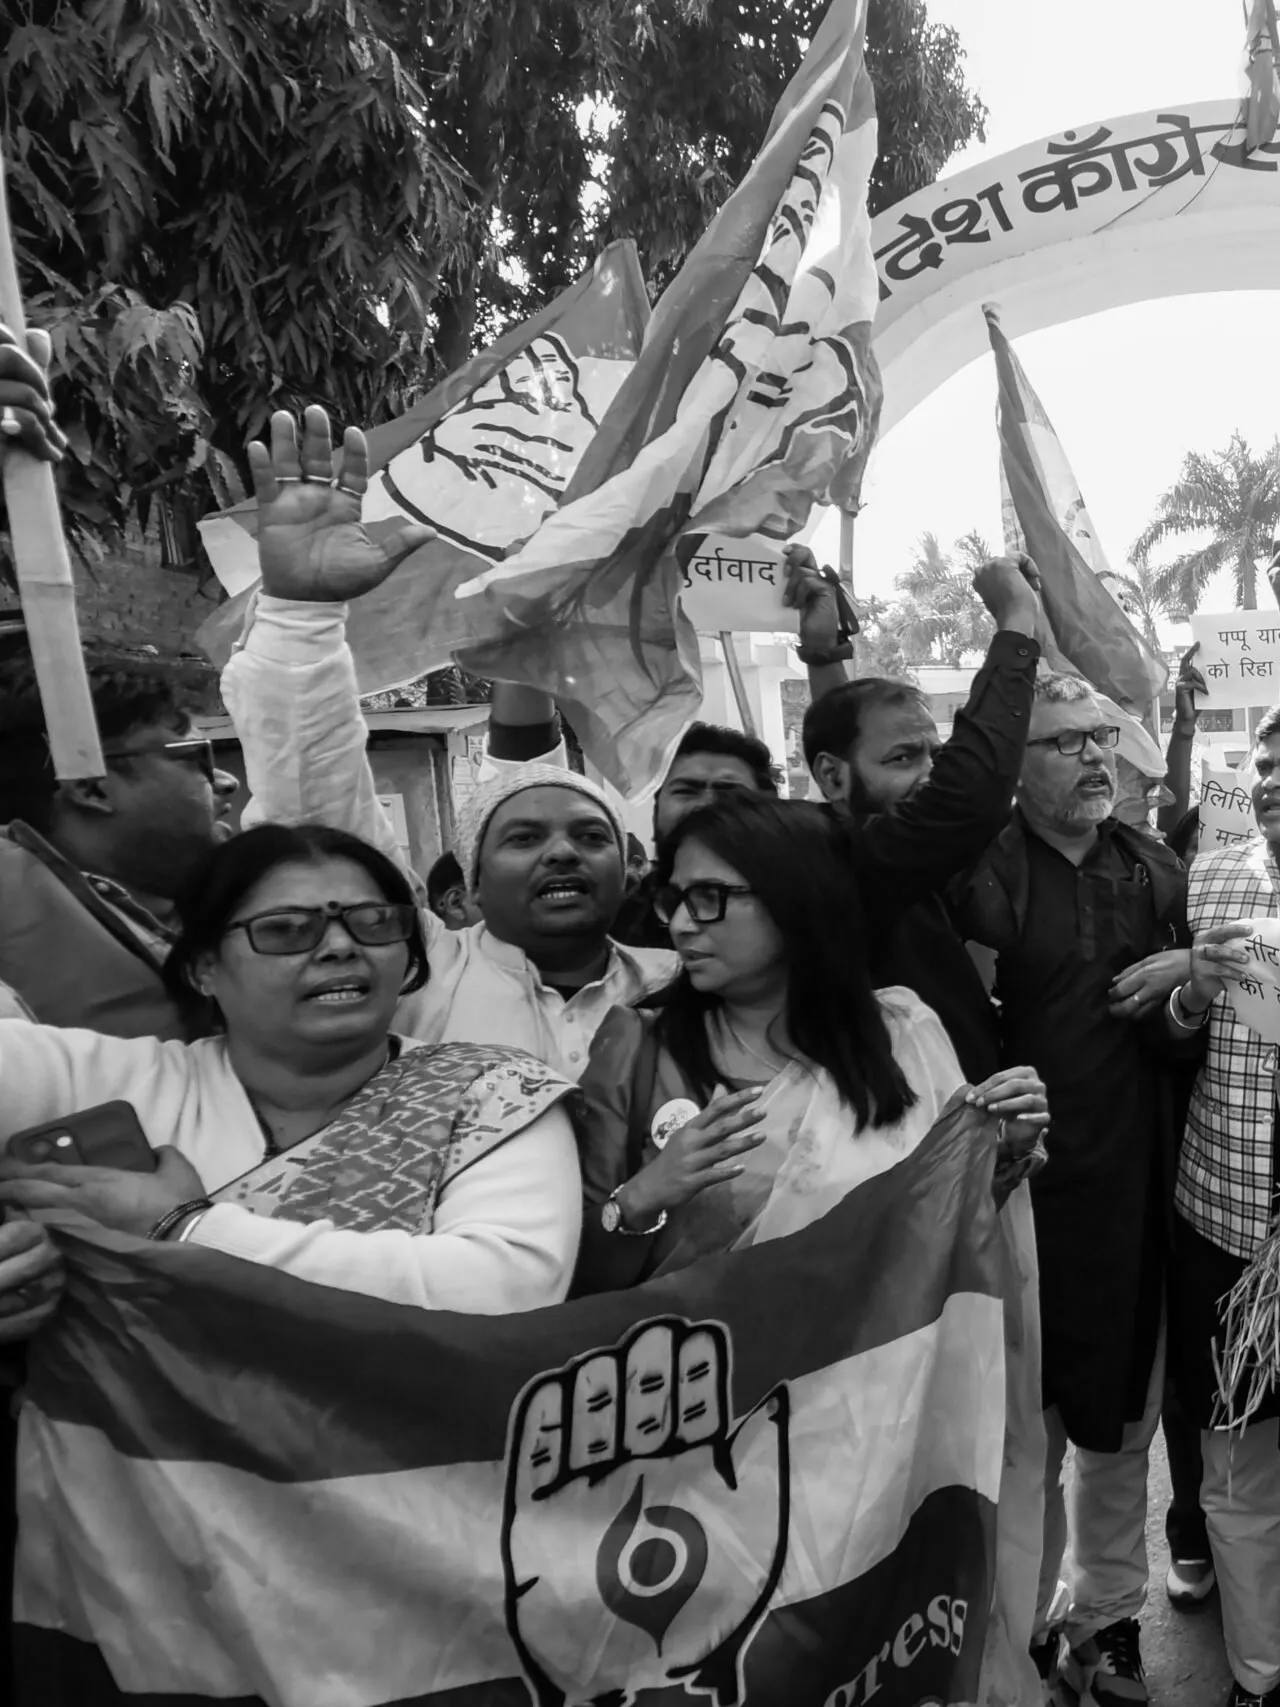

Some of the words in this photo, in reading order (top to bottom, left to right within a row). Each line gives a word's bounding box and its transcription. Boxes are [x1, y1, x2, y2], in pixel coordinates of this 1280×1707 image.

[1218, 630, 1251, 651] पप्पू
[1206, 658, 1230, 678] को
[1239, 657, 1273, 677] रिहा
[1244, 934, 1280, 966] नीट
